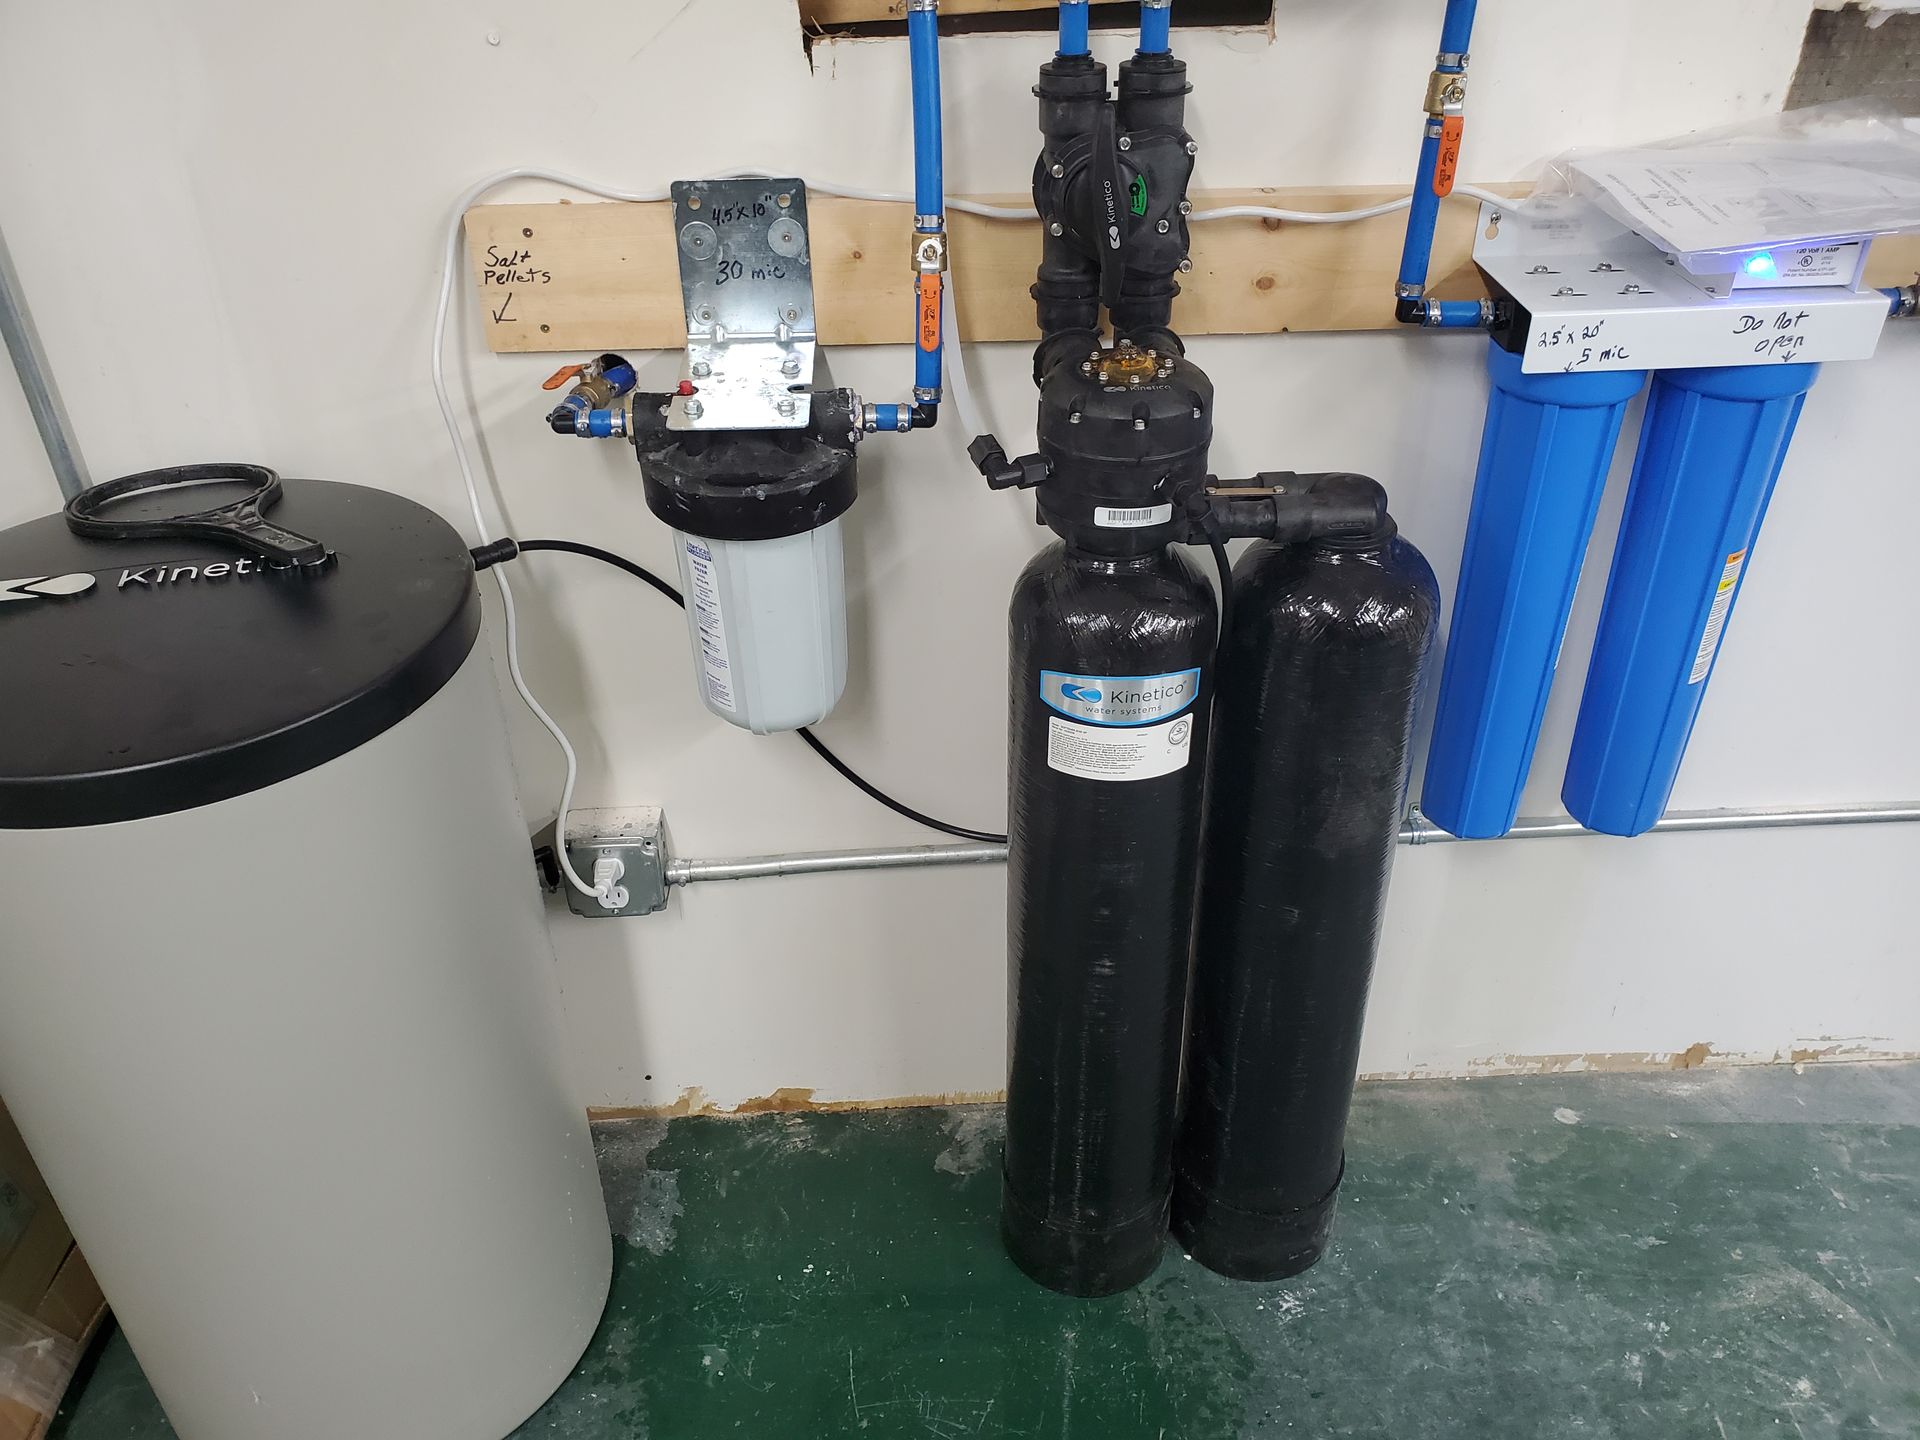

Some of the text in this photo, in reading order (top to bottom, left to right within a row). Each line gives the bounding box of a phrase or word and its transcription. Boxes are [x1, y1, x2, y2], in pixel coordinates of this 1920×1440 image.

[1103, 180, 1116, 224] Kinetico
[484, 245, 531, 267] Salt
[483, 267, 552, 285] Pellets
[716, 260, 786, 285] 30 mic
[1733, 315, 1764, 334] Do
[1576, 345, 1630, 365] 5 mic
[1129, 383, 1171, 392] Kinetico
[1111, 684, 1184, 704] Kinetico
[1085, 704, 1162, 717] water systems
